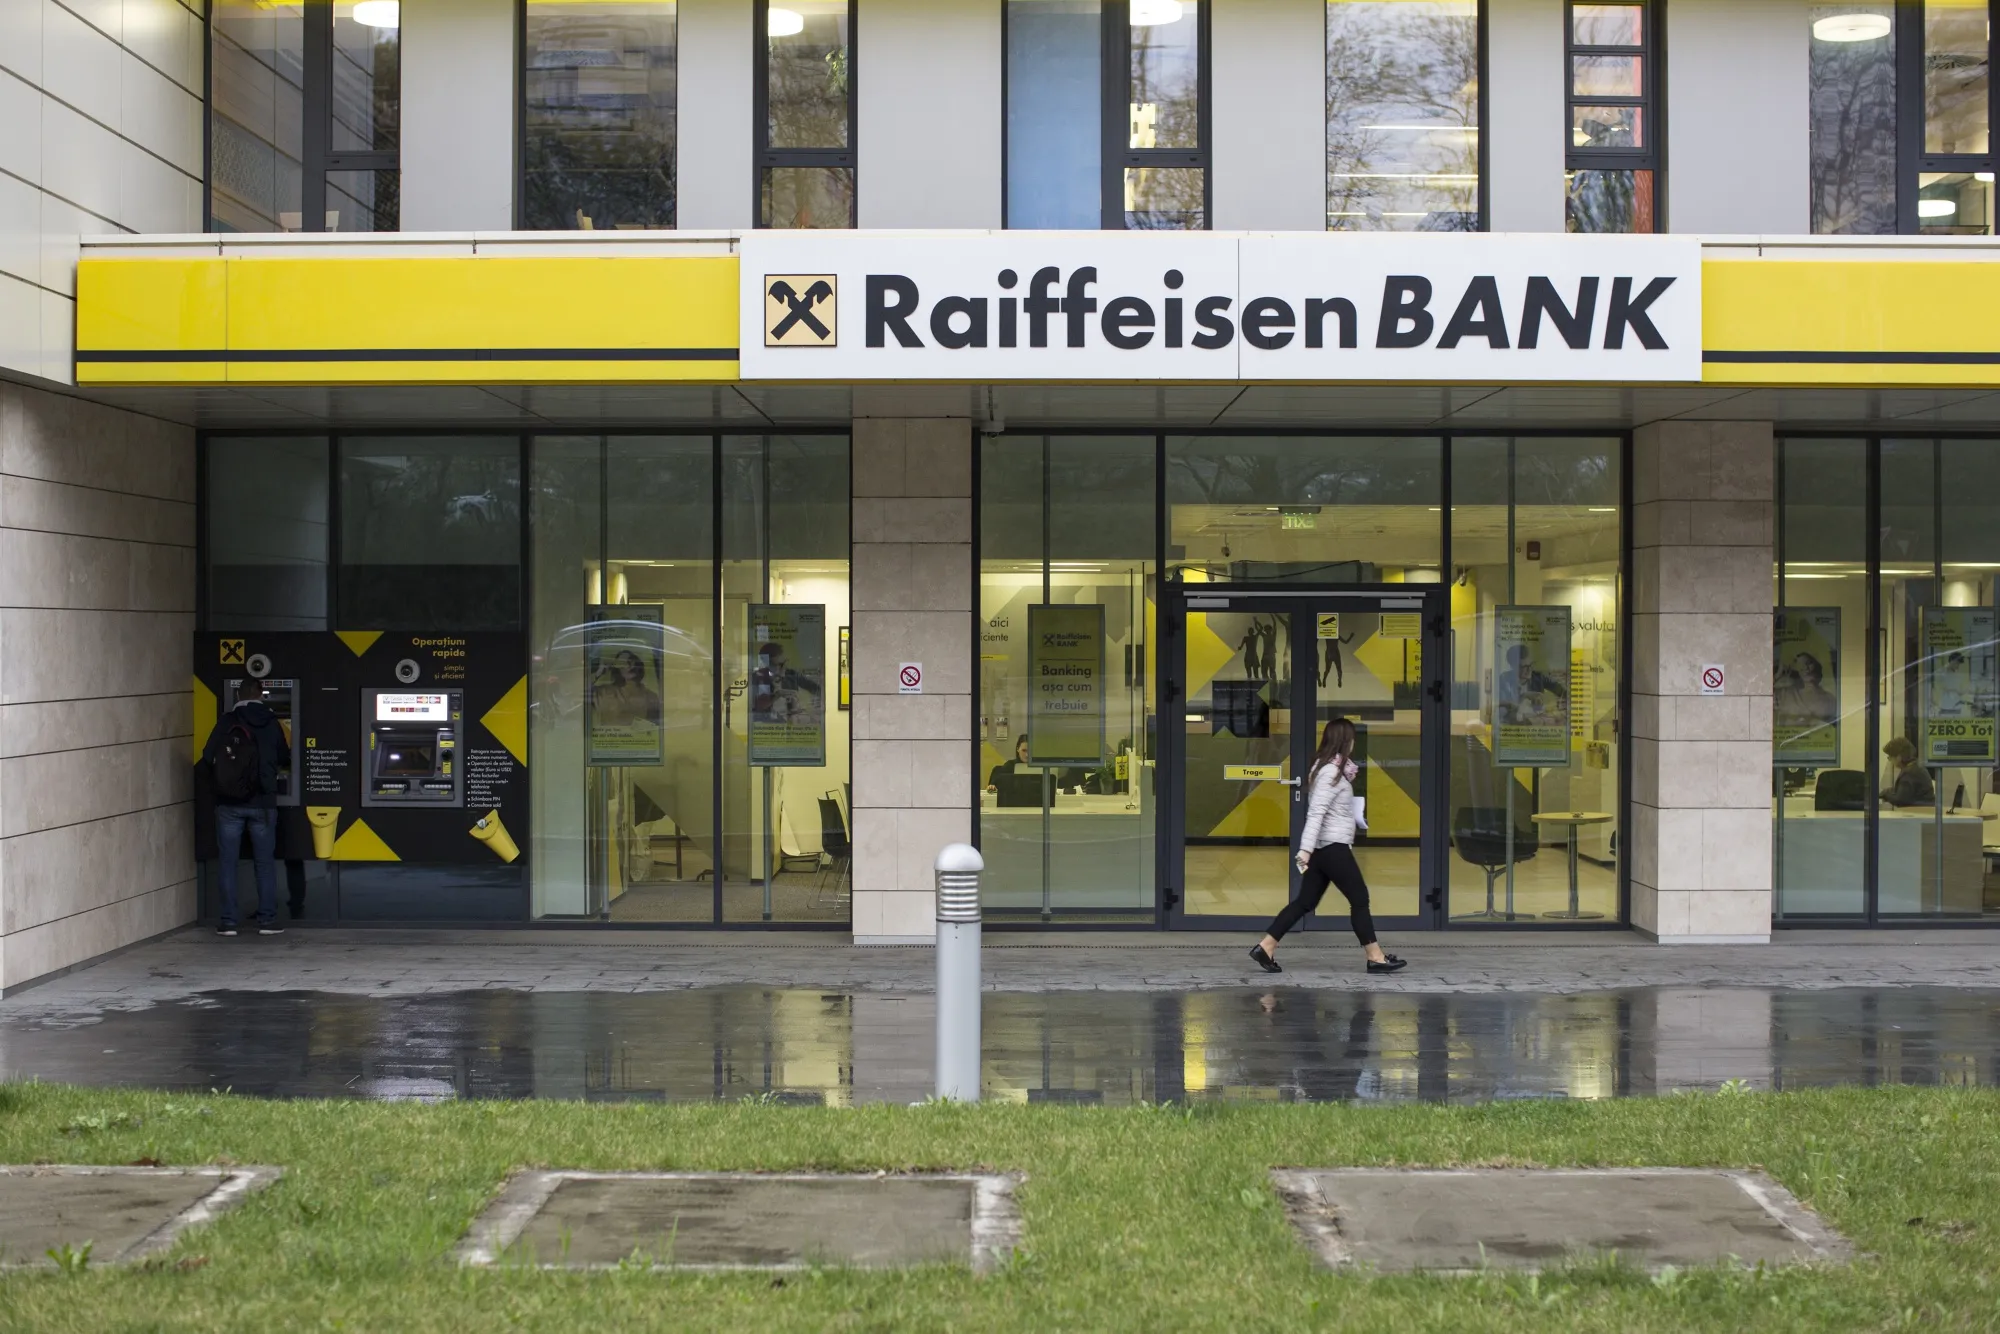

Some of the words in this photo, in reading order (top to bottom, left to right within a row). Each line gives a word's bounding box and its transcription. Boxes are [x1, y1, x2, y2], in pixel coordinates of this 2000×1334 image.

[865, 266, 1357, 349] Raiffeisen
[1376, 275, 1677, 350] BANK
[990, 617, 1009, 628] aici
[1056, 633, 1092, 641] Raiffeisen
[432, 648, 466, 659] rapide
[443, 664, 465, 673] simplu
[1041, 664, 1092, 679] Banking
[1067, 684, 1092, 692] cum
[1045, 698, 1088, 710] trebuie
[1928, 724, 1967, 736] ZERO
[1971, 724, 1993, 736] Tot
